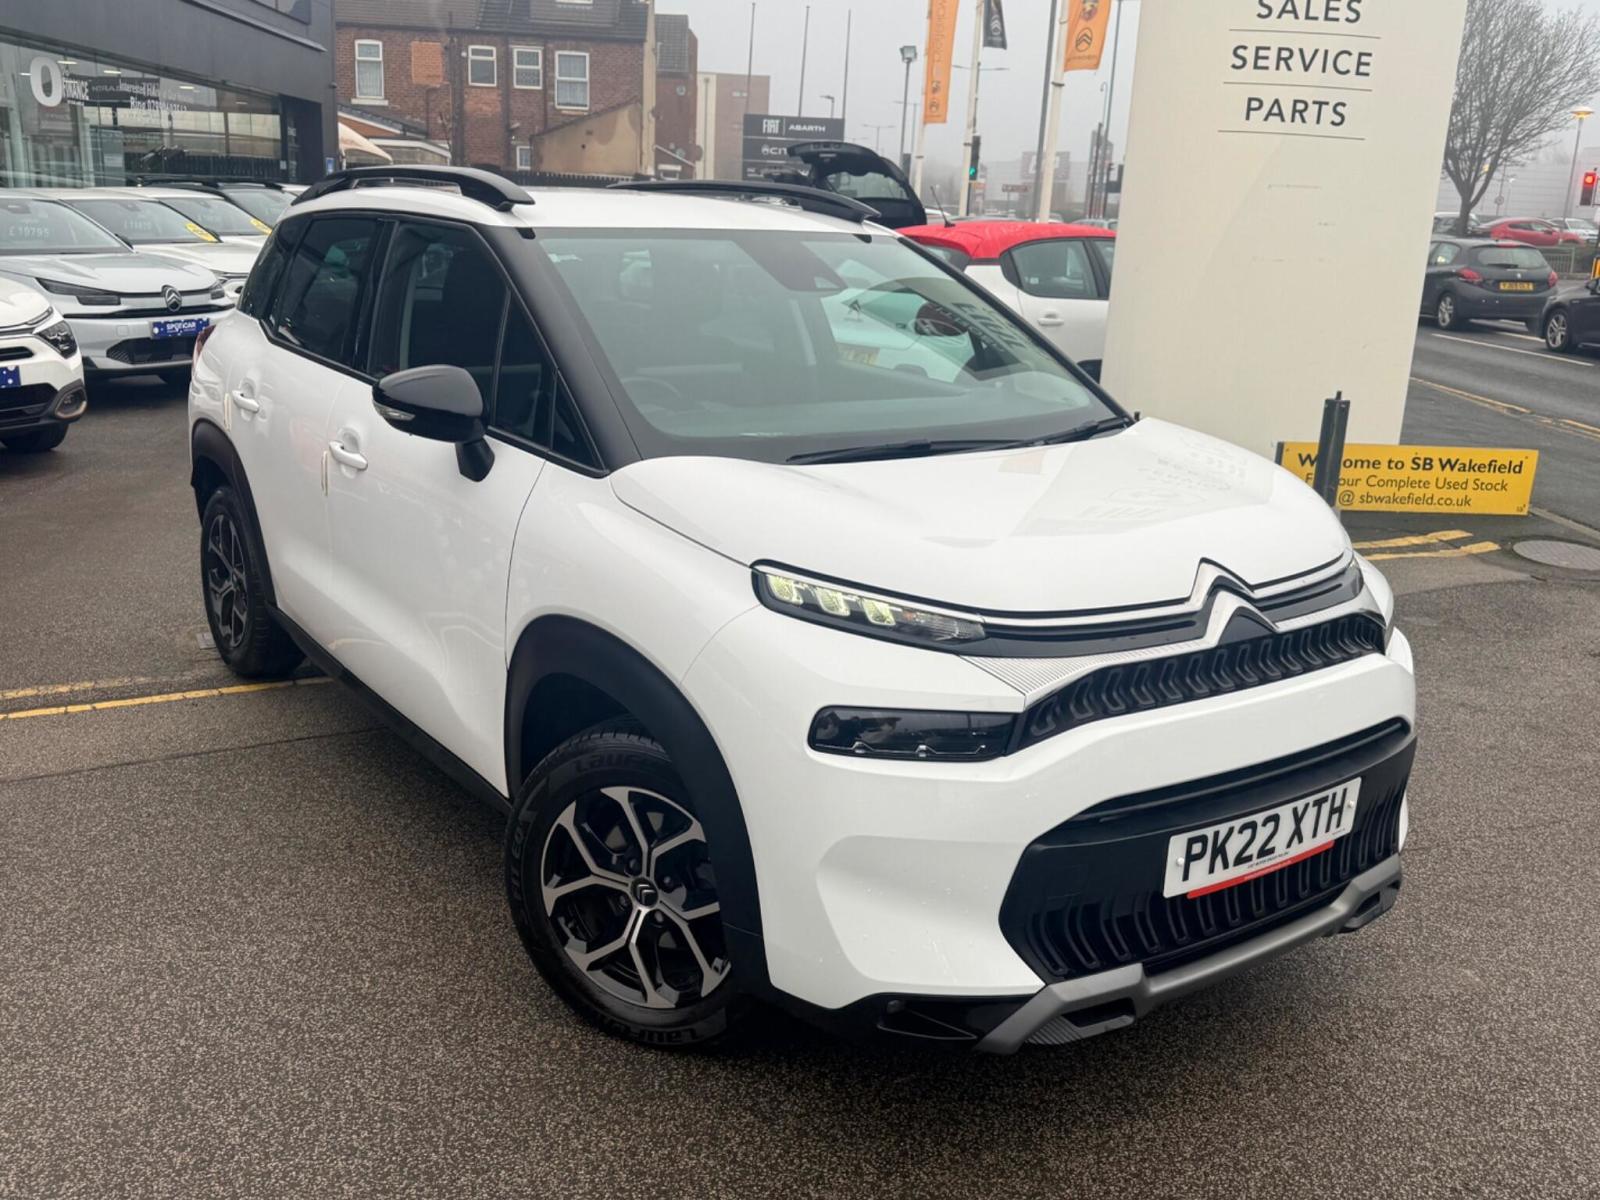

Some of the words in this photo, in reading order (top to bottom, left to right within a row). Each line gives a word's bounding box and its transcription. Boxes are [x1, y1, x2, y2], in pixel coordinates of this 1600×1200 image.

[1256, 0, 1362, 23] SALES
[1231, 45, 1373, 77] SERVICE
[1245, 97, 1347, 126] PARTS
[762, 118, 780, 134] FIAT
[788, 124, 826, 132] ABARTH
[1387, 458, 1405, 471] to
[1410, 456, 1434, 471] SB
[1439, 457, 1524, 474] Wakefield
[1366, 474, 1431, 492] Complete
[1435, 477, 1469, 491] Used
[1472, 478, 1509, 492] Stock
[1338, 489, 1355, 506] @
[1359, 490, 1472, 507] sbwakefield.co.uk
[1182, 812, 1281, 882] PK22
[1286, 787, 1348, 850] XTH
